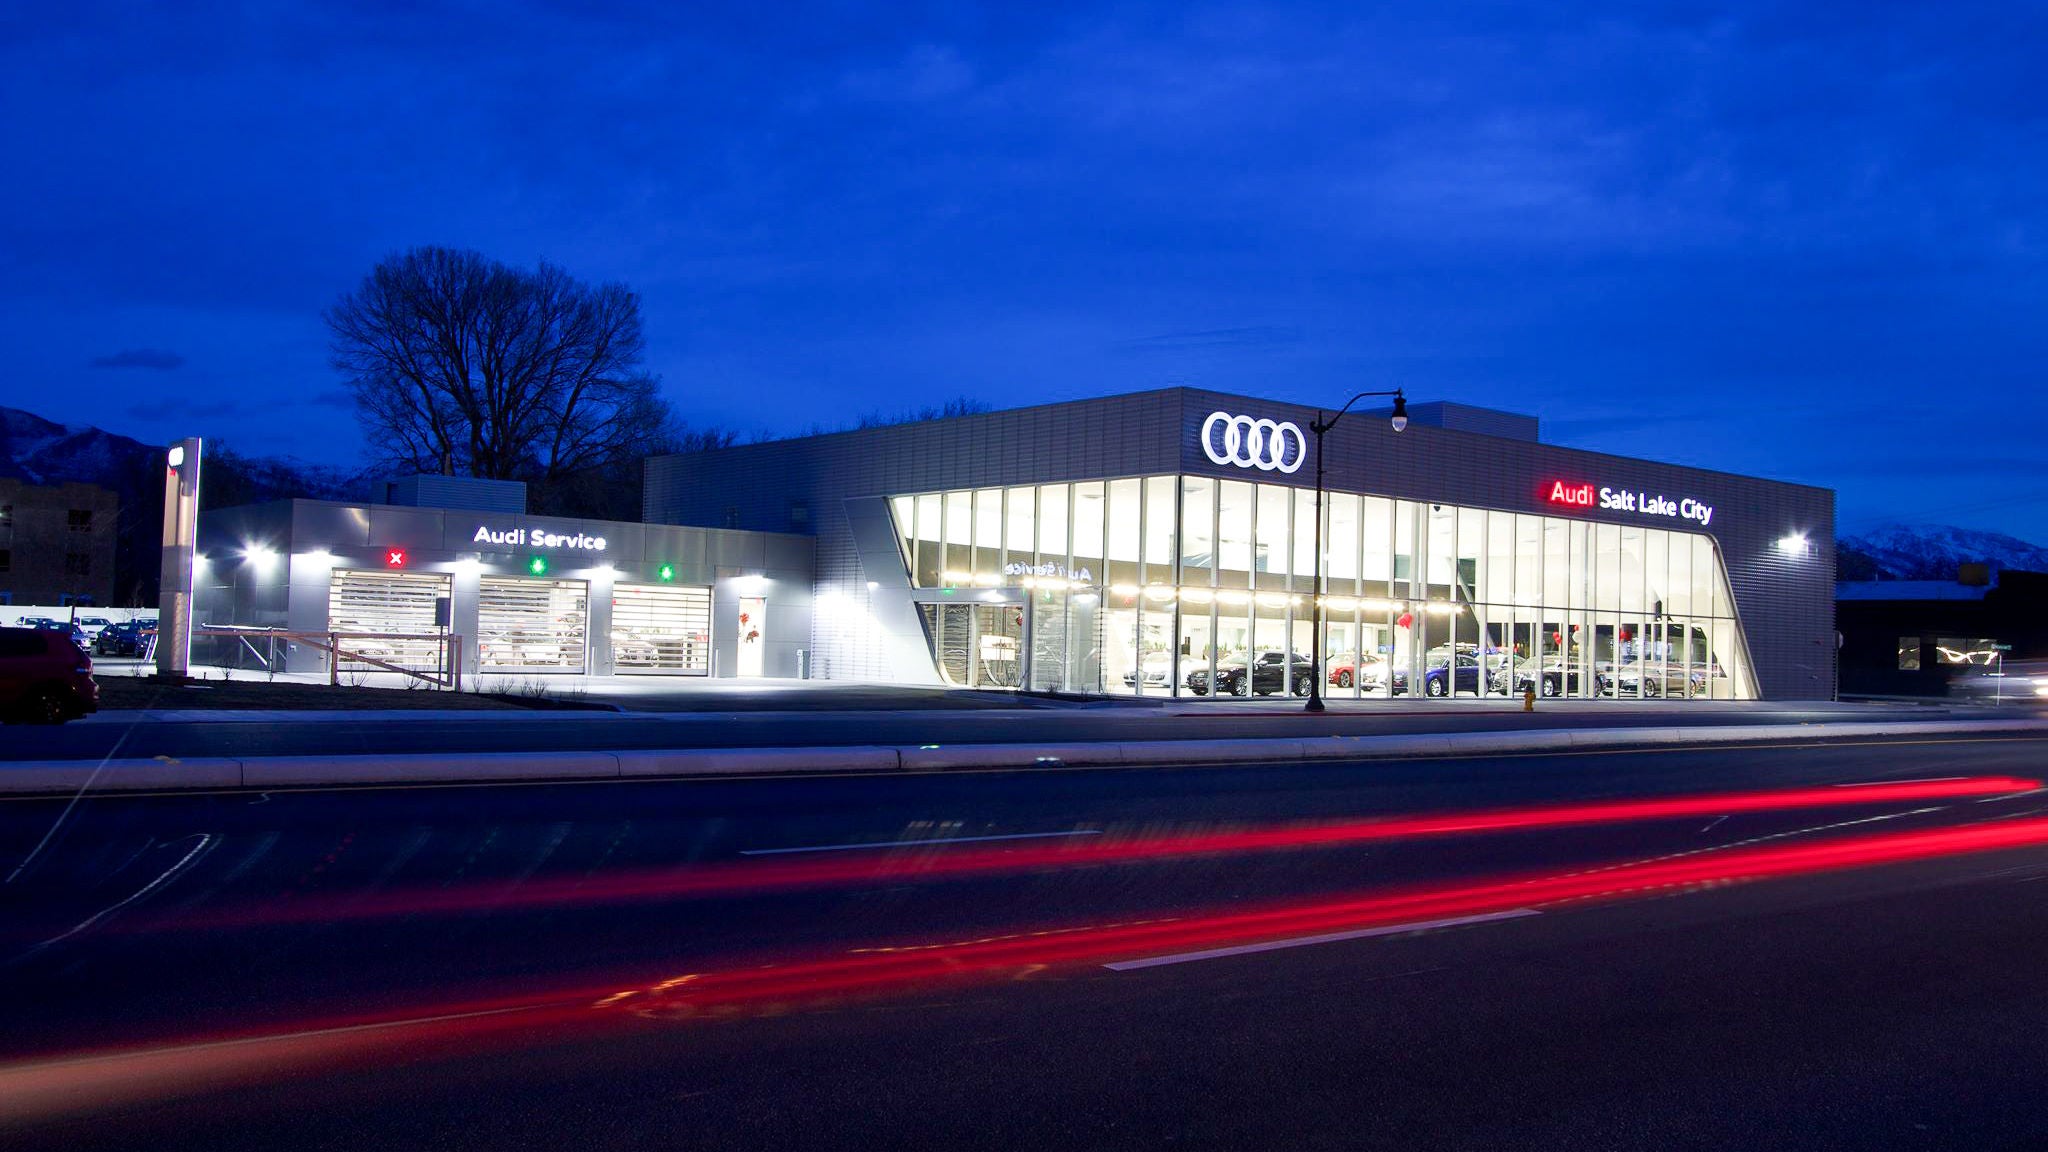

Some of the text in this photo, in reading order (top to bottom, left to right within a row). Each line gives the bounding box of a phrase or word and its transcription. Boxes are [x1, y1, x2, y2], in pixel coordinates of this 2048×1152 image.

[1551, 481, 1713, 526] Audi Salt Lake City
[474, 526, 607, 551] Audi Service
